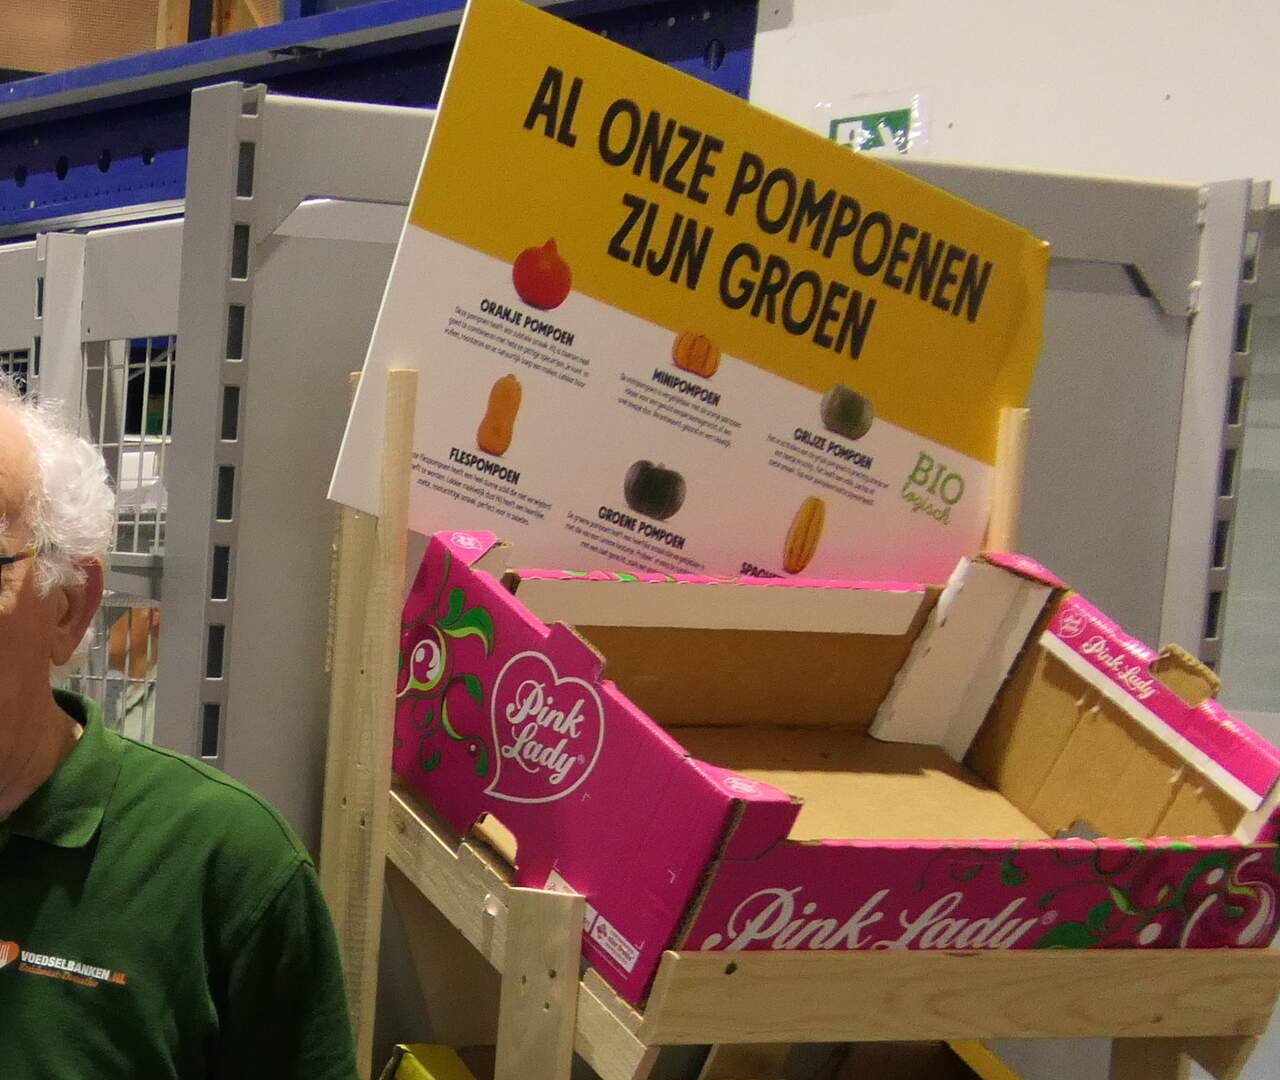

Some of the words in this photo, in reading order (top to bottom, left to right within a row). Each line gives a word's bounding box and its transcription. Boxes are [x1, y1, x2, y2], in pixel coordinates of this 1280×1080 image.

[523, 65, 584, 149] AL
[597, 98, 725, 205] ONZE
[725, 151, 995, 325] POMPOENEN
[606, 193, 714, 291] ZIJN
[719, 242, 877, 361] GROEN
[480, 298, 521, 331] ORANJE
[522, 310, 575, 347] POMPOEN
[651, 367, 722, 408] MINIPOMPOEN
[448, 447, 521, 486] FLESPOMPOEN
[793, 427, 830, 458] GRIJZE
[829, 439, 873, 471] POMPOEN
[908, 451, 965, 505] BIO
[597, 506, 638, 537] GROENE
[638, 517, 687, 551] POMPOEN
[1082, 635, 1125, 671] Pink
[1118, 666, 1157, 699] Lady
[506, 680, 585, 738] Pink
[501, 722, 577, 785] Lady
[701, 886, 891, 950] Pink
[871, 891, 1039, 950] Lady
